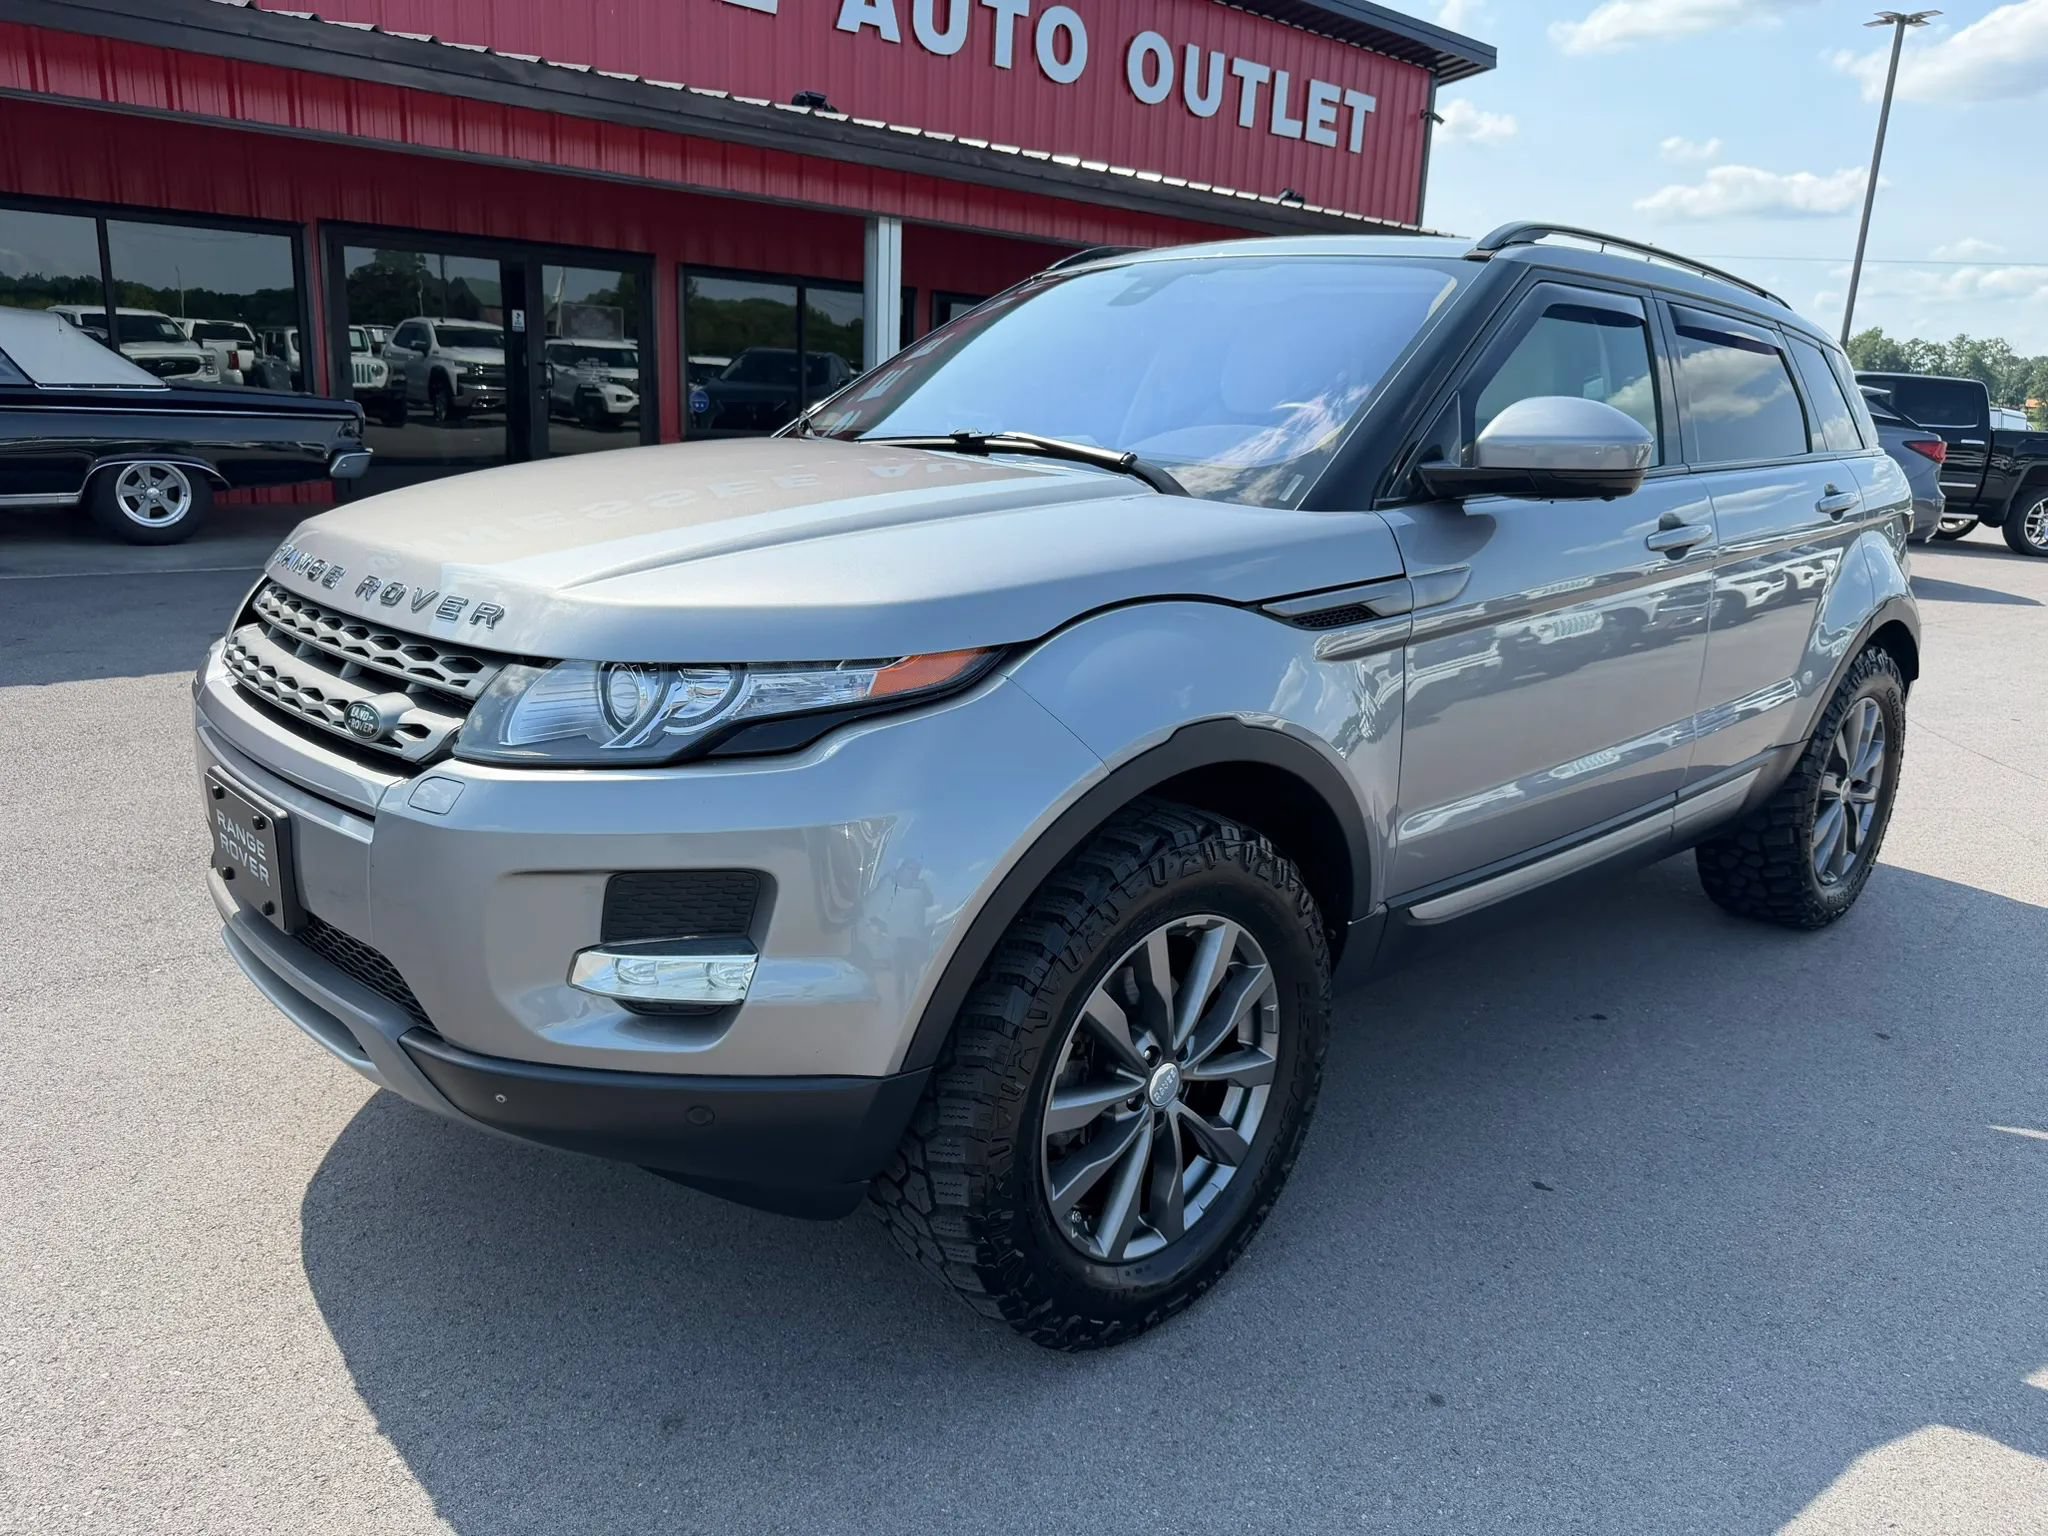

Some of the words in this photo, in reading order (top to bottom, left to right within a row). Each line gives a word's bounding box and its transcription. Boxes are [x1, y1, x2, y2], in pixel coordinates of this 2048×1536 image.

[1127, 30, 1377, 153] OUTLET
[273, 543, 347, 590] RANGE
[354, 574, 506, 630] ROVER
[350, 718, 374, 734] ROVER
[216, 808, 267, 862] RANGE
[219, 832, 271, 888] ROVER
